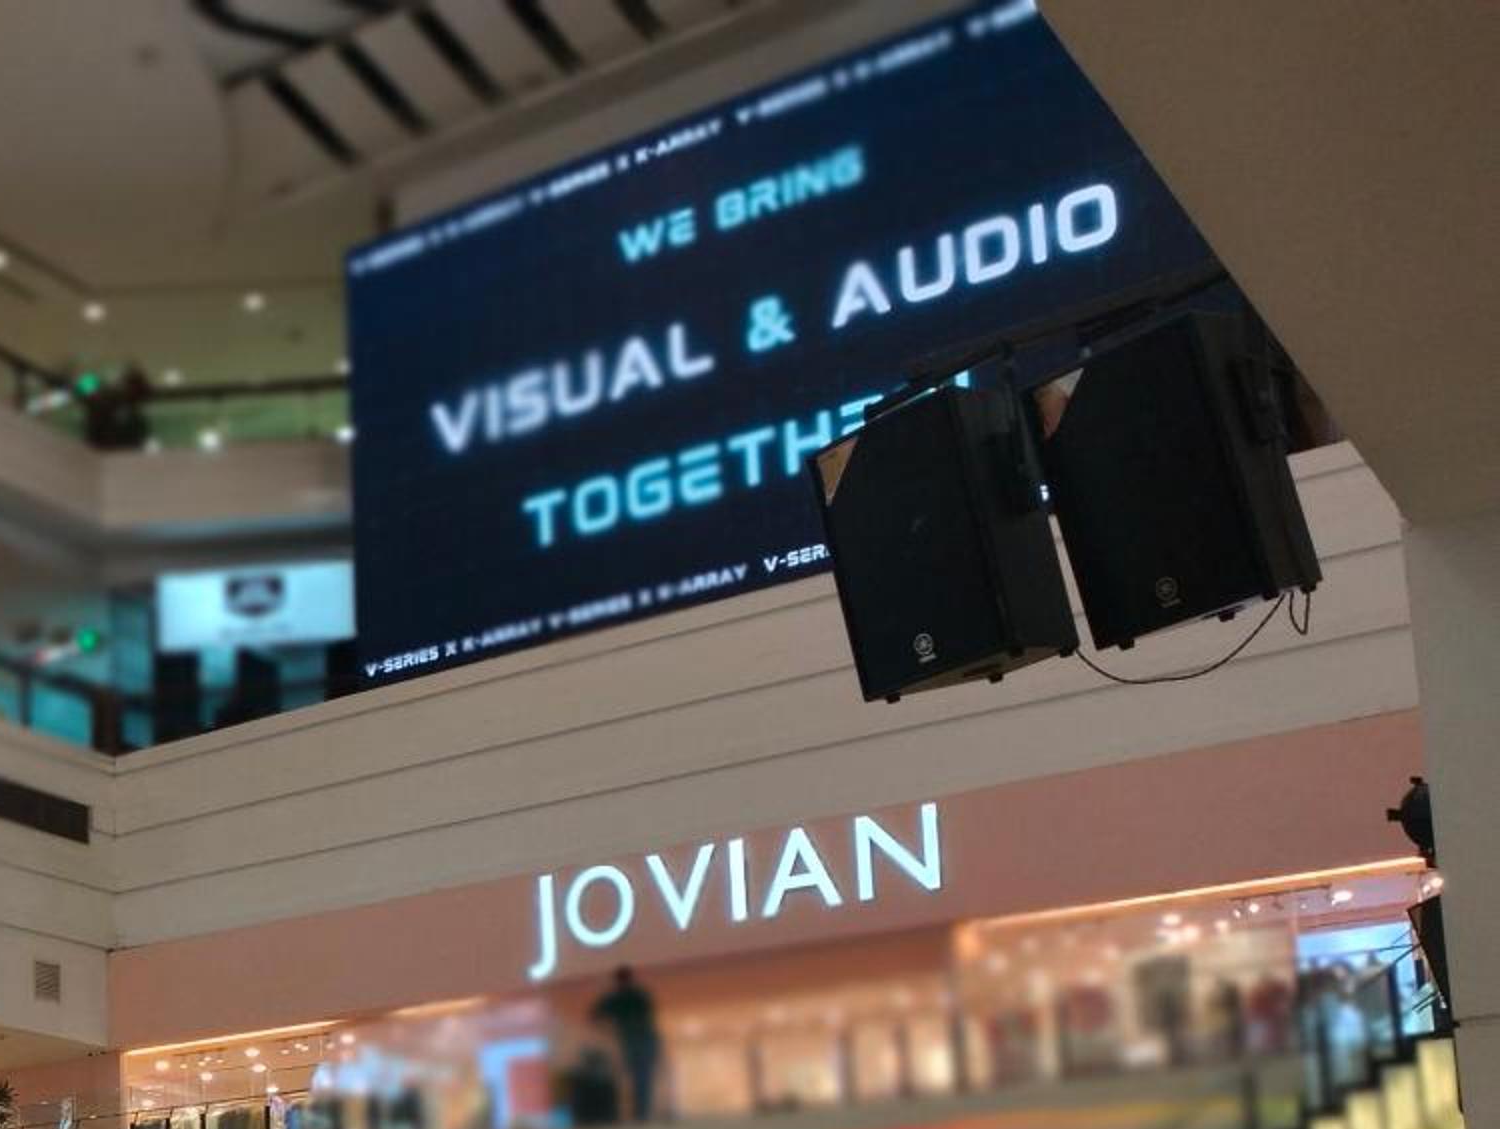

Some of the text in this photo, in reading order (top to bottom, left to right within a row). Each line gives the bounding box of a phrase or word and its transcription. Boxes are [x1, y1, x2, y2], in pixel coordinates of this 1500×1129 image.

[617, 144, 866, 263] WE BRING
[430, 183, 1120, 456] VISUAL & AUDIO
[364, 646, 439, 678] V-SERIES
[444, 640, 458, 657] X
[762, 543, 832, 574] V-SER
[526, 800, 942, 982] JOVIAN
